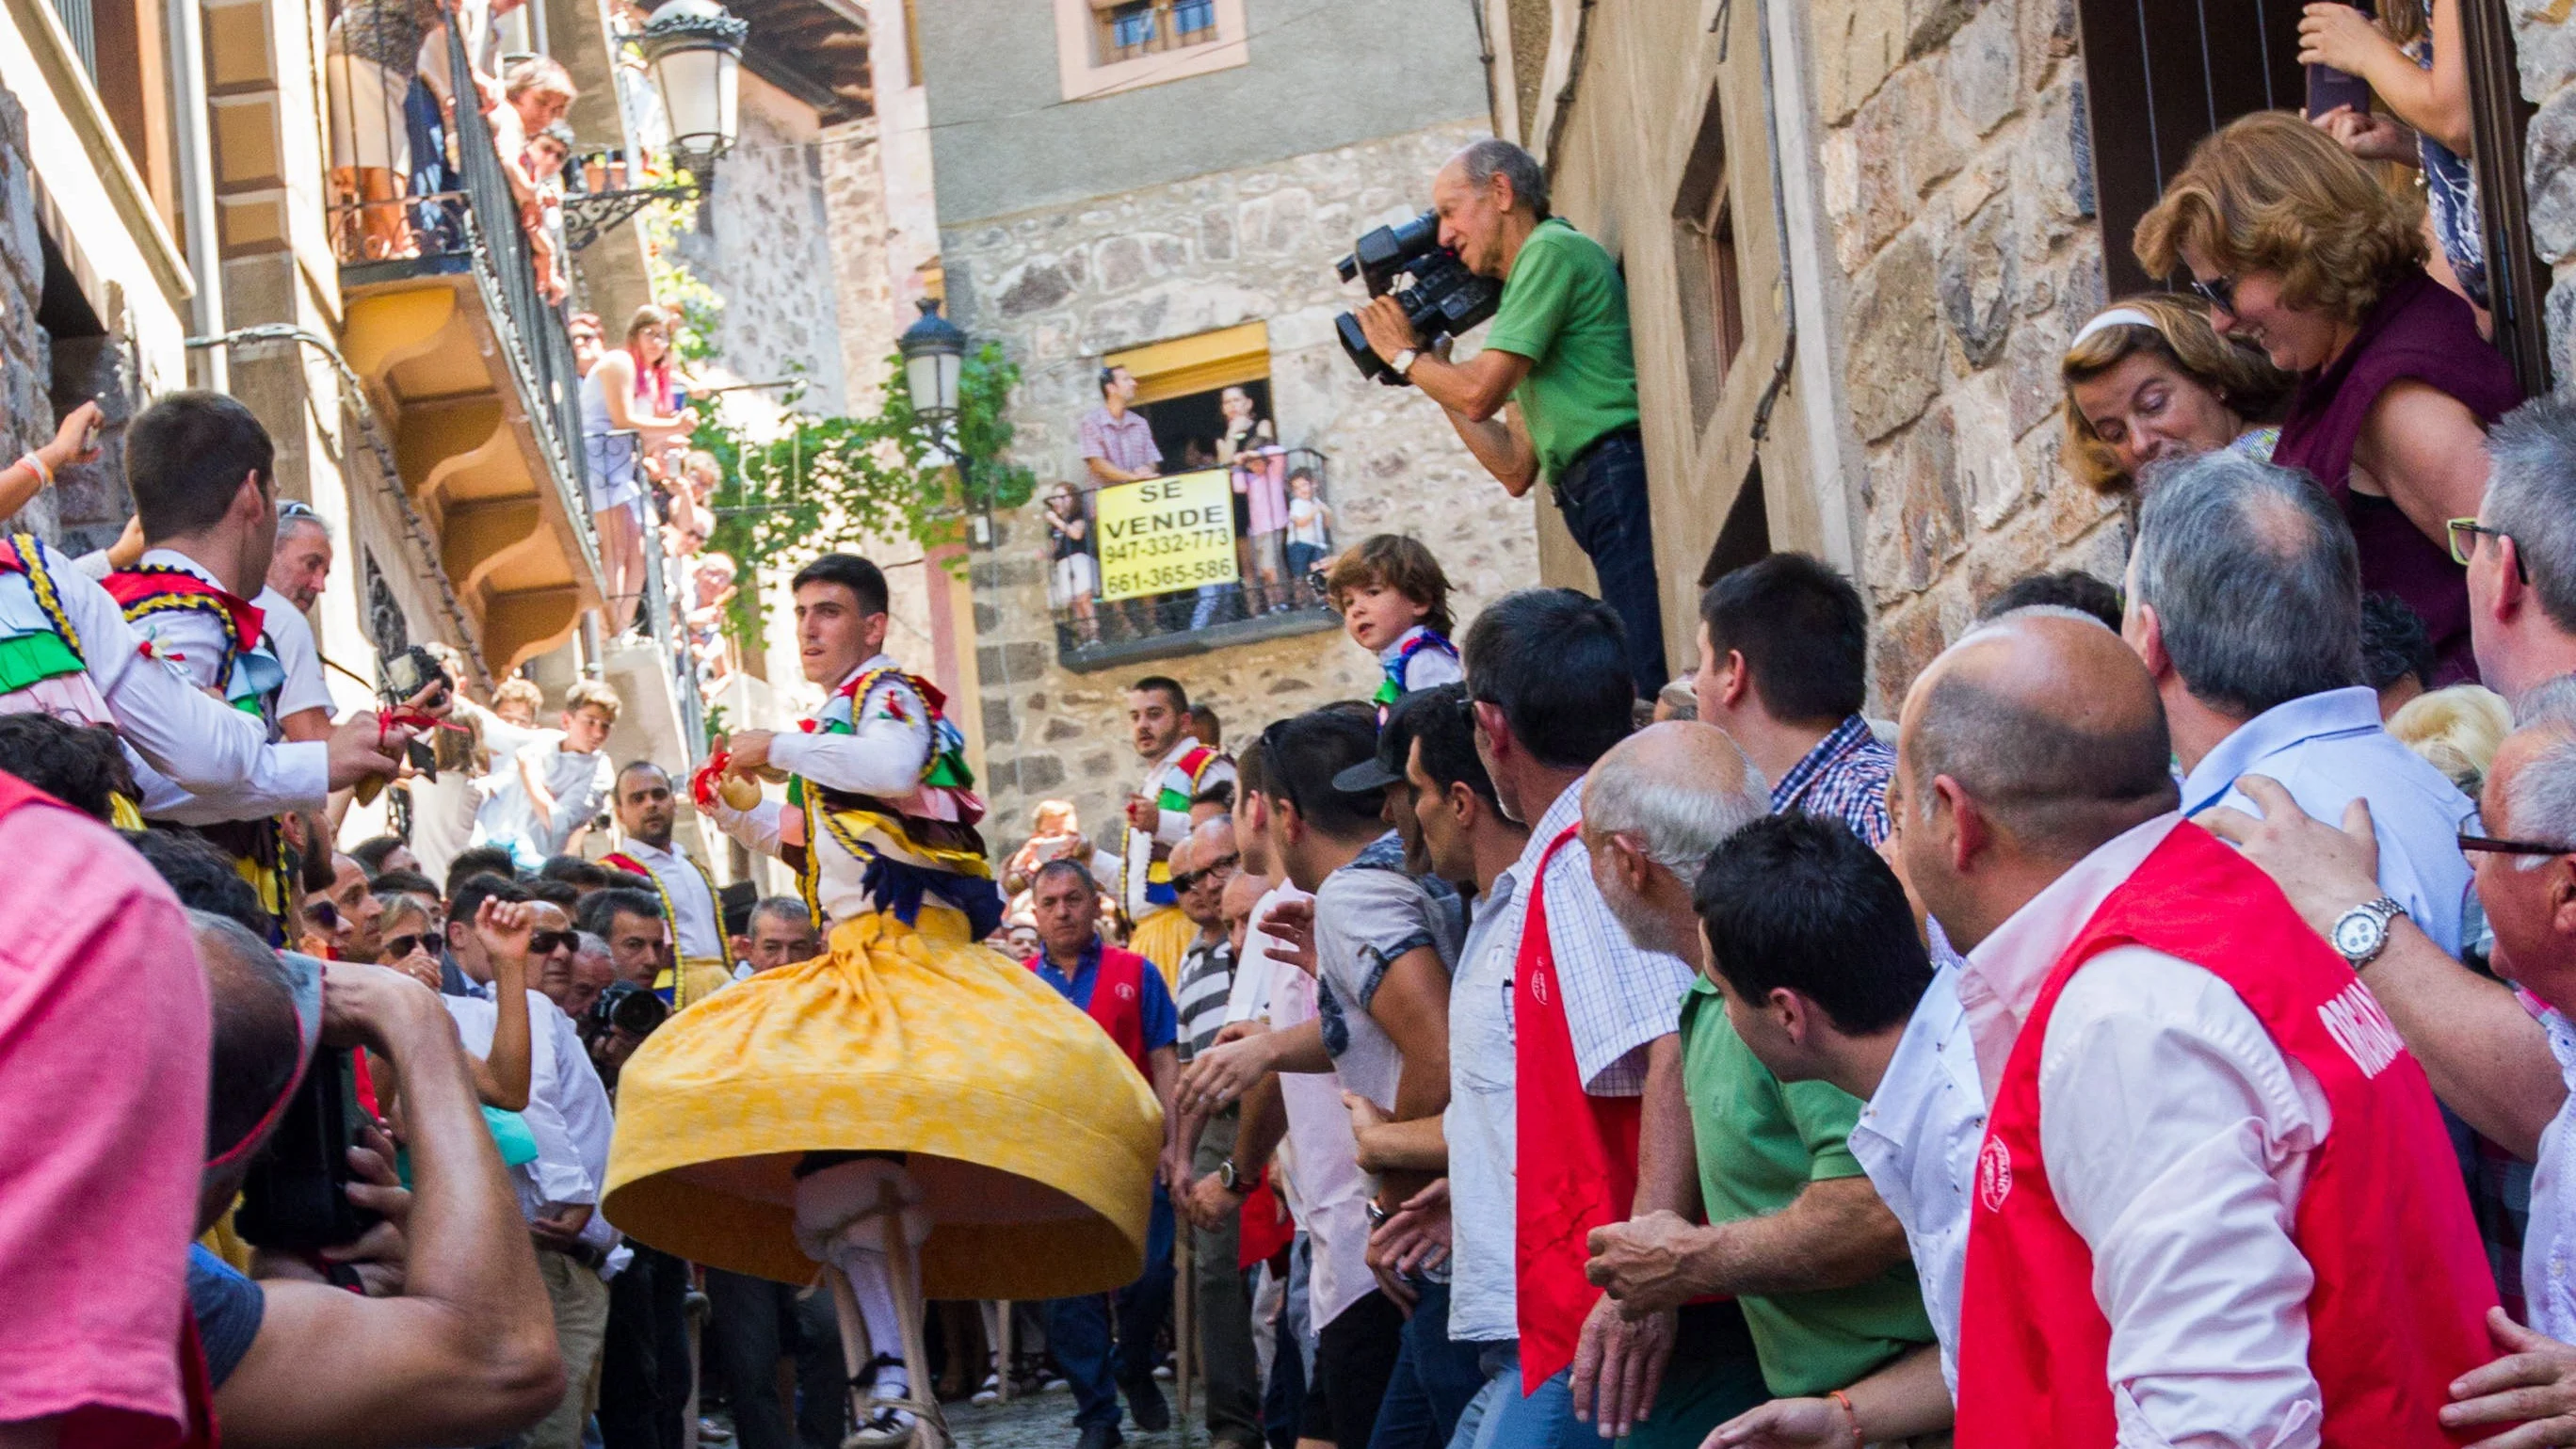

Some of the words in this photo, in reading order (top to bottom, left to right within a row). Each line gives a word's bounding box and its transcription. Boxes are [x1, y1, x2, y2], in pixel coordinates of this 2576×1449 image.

[1140, 480, 1183, 503] SE
[1105, 505, 1224, 539] VENDE
[1105, 527, 1229, 565] 947-332-773
[1107, 558, 1231, 594] 661-365-586
